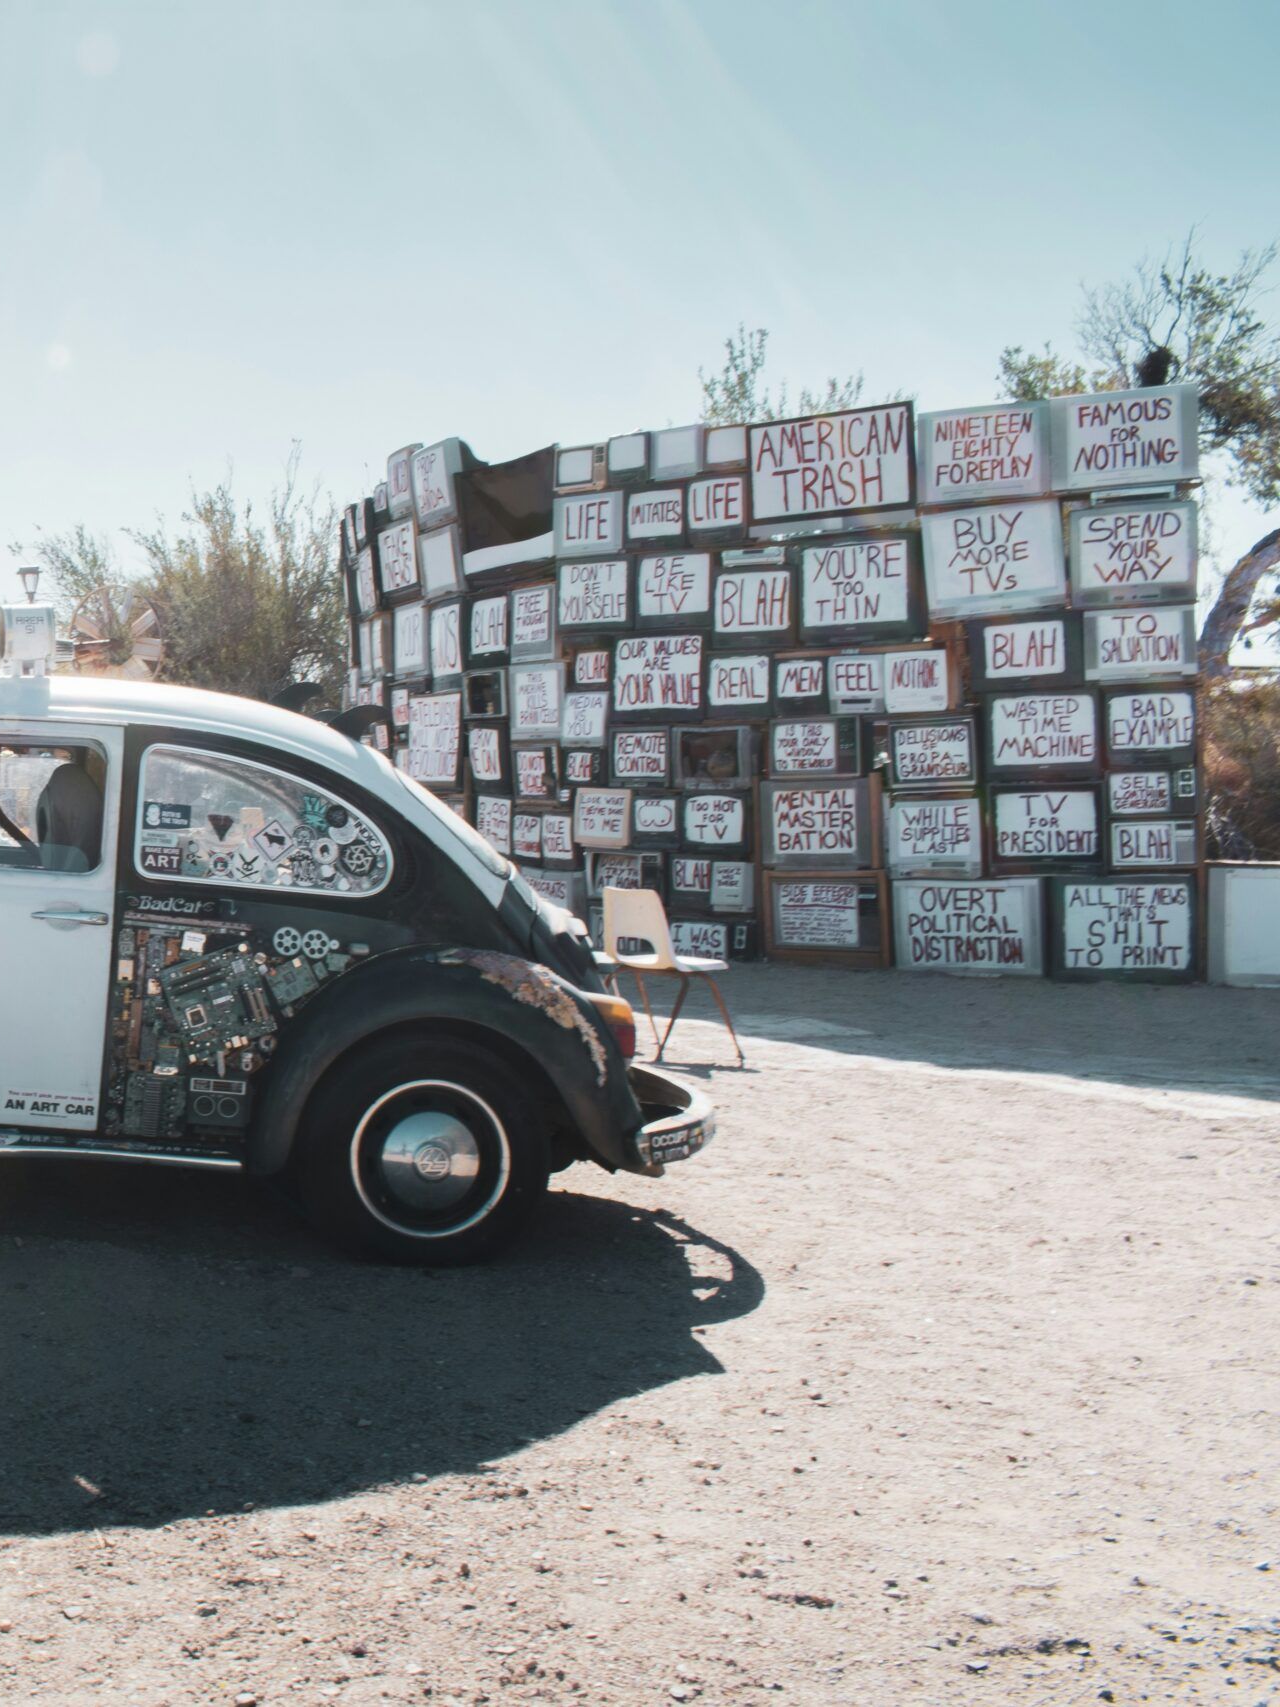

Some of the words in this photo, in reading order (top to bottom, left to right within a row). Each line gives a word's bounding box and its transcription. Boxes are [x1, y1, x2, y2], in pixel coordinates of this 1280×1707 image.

[1078, 397, 1172, 428] FAMOUS
[934, 413, 1032, 442] NINETEEN
[1111, 427, 1141, 442] FOR
[756, 410, 906, 472] AMERICAN
[952, 435, 1019, 461] EIGHTY
[1074, 438, 1179, 471] NOTHING
[936, 453, 1032, 486] FOREPLAY
[772, 457, 883, 512] TRASH
[631, 501, 681, 525] IMITATES
[692, 481, 740, 522] LIFE
[565, 500, 609, 540] LIFE
[954, 511, 1023, 549] BUY
[1083, 512, 1181, 543] SPEND
[948, 541, 1029, 567] MORE
[1108, 539, 1160, 561] YOUR
[571, 563, 616, 584] DON'T
[654, 557, 685, 578] BE
[813, 543, 902, 583] YOU'RE
[1094, 557, 1173, 583] WAY
[584, 583, 601, 596] BE
[644, 574, 696, 593] LIKE
[832, 581, 864, 597] TOO
[959, 564, 1017, 594] TVs
[563, 594, 626, 623] YOURSELF
[652, 593, 688, 612] TV
[722, 576, 789, 628] BLAH
[816, 594, 880, 621] THIN
[473, 600, 504, 648] BLAH
[1111, 614, 1158, 636] TO
[619, 640, 647, 660] OUR
[654, 637, 699, 656] VALUES
[992, 627, 1057, 670] BLAH
[1101, 633, 1180, 664] SALVATION
[578, 654, 609, 680] BLAH
[643, 657, 672, 671] ARE
[891, 658, 938, 690] NOTHING
[781, 665, 823, 694] MEN
[835, 663, 879, 692] FEEL
[618, 674, 654, 706] YOUR
[1000, 697, 1079, 719] WASTED
[1131, 697, 1175, 719] BAD
[568, 720, 593, 737] YOU
[785, 725, 795, 736] IS
[801, 724, 822, 736] THIS
[898, 726, 967, 746] DELUSIONS
[1018, 716, 1072, 735] TIME
[1111, 716, 1192, 747] EXAMPLE
[618, 735, 666, 754] REMOTE
[803, 737, 830, 747] ONLY
[997, 734, 1093, 759] MACHINE
[567, 754, 593, 779] BLAH
[615, 754, 666, 774] CONTROL
[899, 763, 970, 778] GRANDEUR
[1120, 776, 1167, 789] SELF
[690, 800, 709, 811] TOO
[712, 800, 738, 813] HOT
[775, 789, 854, 812] MENTAL
[1019, 794, 1069, 816] TV
[582, 818, 596, 830] TO
[602, 818, 622, 832] ME
[702, 814, 725, 823] FOR
[778, 810, 855, 831] MASTER
[902, 806, 969, 828] WHILE
[1029, 817, 1059, 828] FOR
[778, 830, 853, 851] BATION
[901, 826, 971, 843] SUPPLIES
[1000, 830, 1094, 854] PRESIDENT
[1120, 829, 1171, 860] BLAH
[912, 841, 958, 854] LAST
[144, 855, 179, 868] ART
[675, 860, 710, 890] BLAH
[138, 895, 202, 914] BadCat
[920, 887, 1006, 914] OVERT
[1069, 888, 1111, 907] ALL
[1115, 887, 1145, 901] THE
[1153, 887, 1188, 905] NEWS
[908, 913, 1019, 935] POLITICAL
[1103, 904, 1157, 922] THAT'S
[672, 925, 683, 942] I
[690, 927, 722, 948] WAS
[1087, 919, 1169, 947] SHIT
[912, 935, 1024, 964] DISTRACTION
[1069, 947, 1105, 966] TO
[1121, 946, 1183, 967] PRINT
[4, 1099, 25, 1110] AN
[30, 1101, 60, 1112] ART
[65, 1103, 95, 1115] CAR
